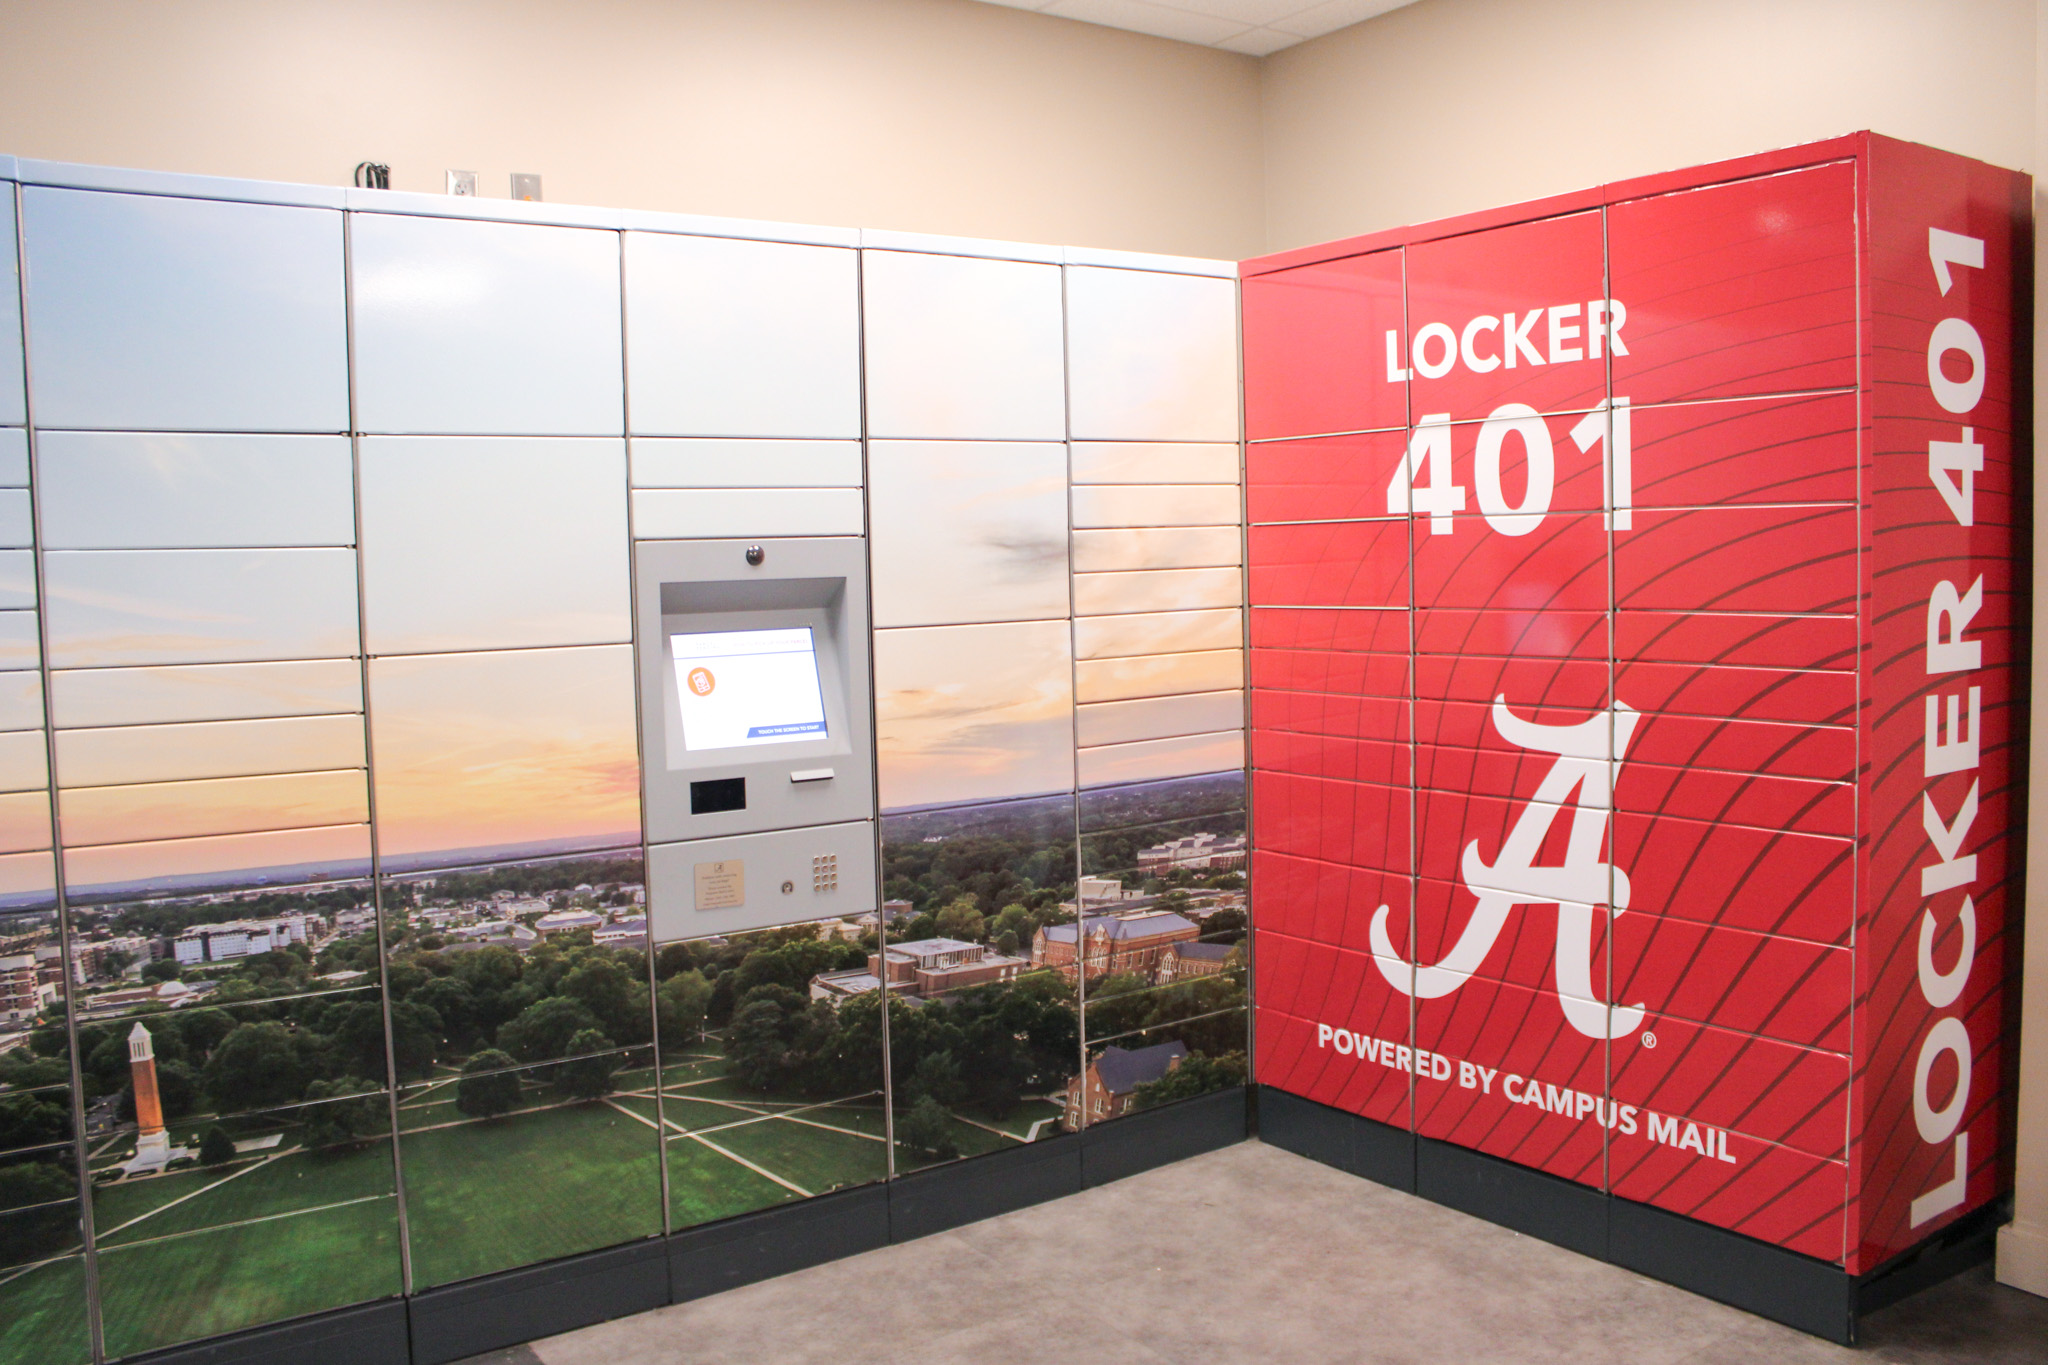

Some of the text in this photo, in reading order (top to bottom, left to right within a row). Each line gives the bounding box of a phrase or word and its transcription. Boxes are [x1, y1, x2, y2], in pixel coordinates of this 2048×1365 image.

[1385, 298, 1630, 383] LOCKER
[1386, 395, 1633, 537] 401
[1910, 226, 1986, 1230] LOCKER 401
[1369, 692, 1646, 1040] A
[1317, 1022, 1737, 1165] POWERED BY CAMPUS MAIL
